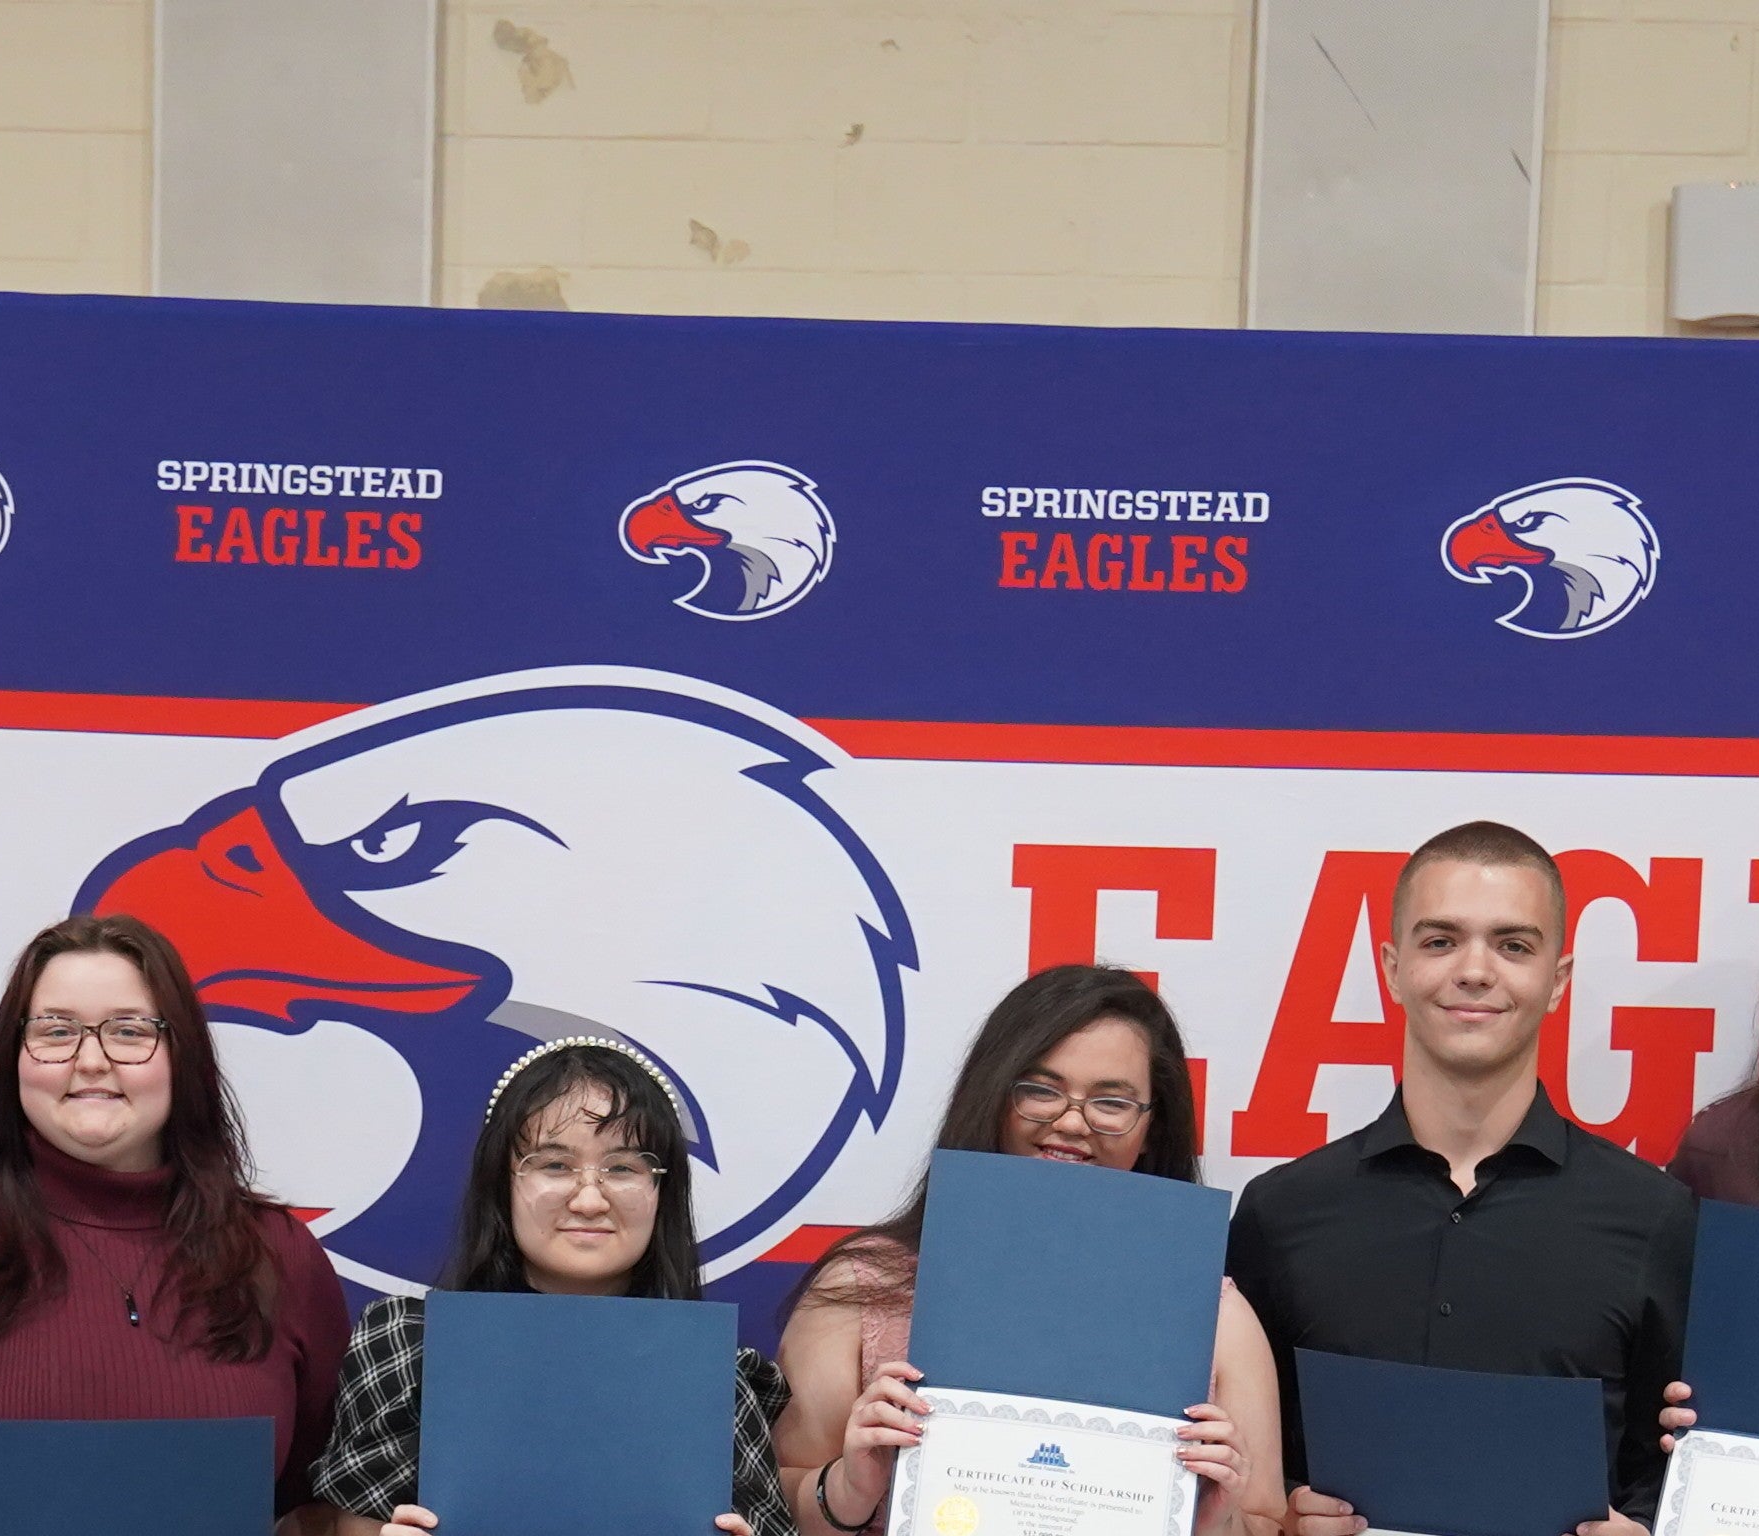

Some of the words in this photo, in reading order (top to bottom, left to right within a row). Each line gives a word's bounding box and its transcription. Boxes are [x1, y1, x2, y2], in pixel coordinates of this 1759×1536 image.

[157, 460, 443, 500] SPRINGSTEAD
[981, 486, 1270, 523] SPRINGSTEAD
[174, 505, 423, 570] EAGLES
[998, 531, 1248, 593] EAGLES
[946, 1464, 1035, 1486] CERTIFICATE
[1039, 1478, 1057, 1489] OF
[1060, 1479, 1155, 1502] SCHOLARSHIP
